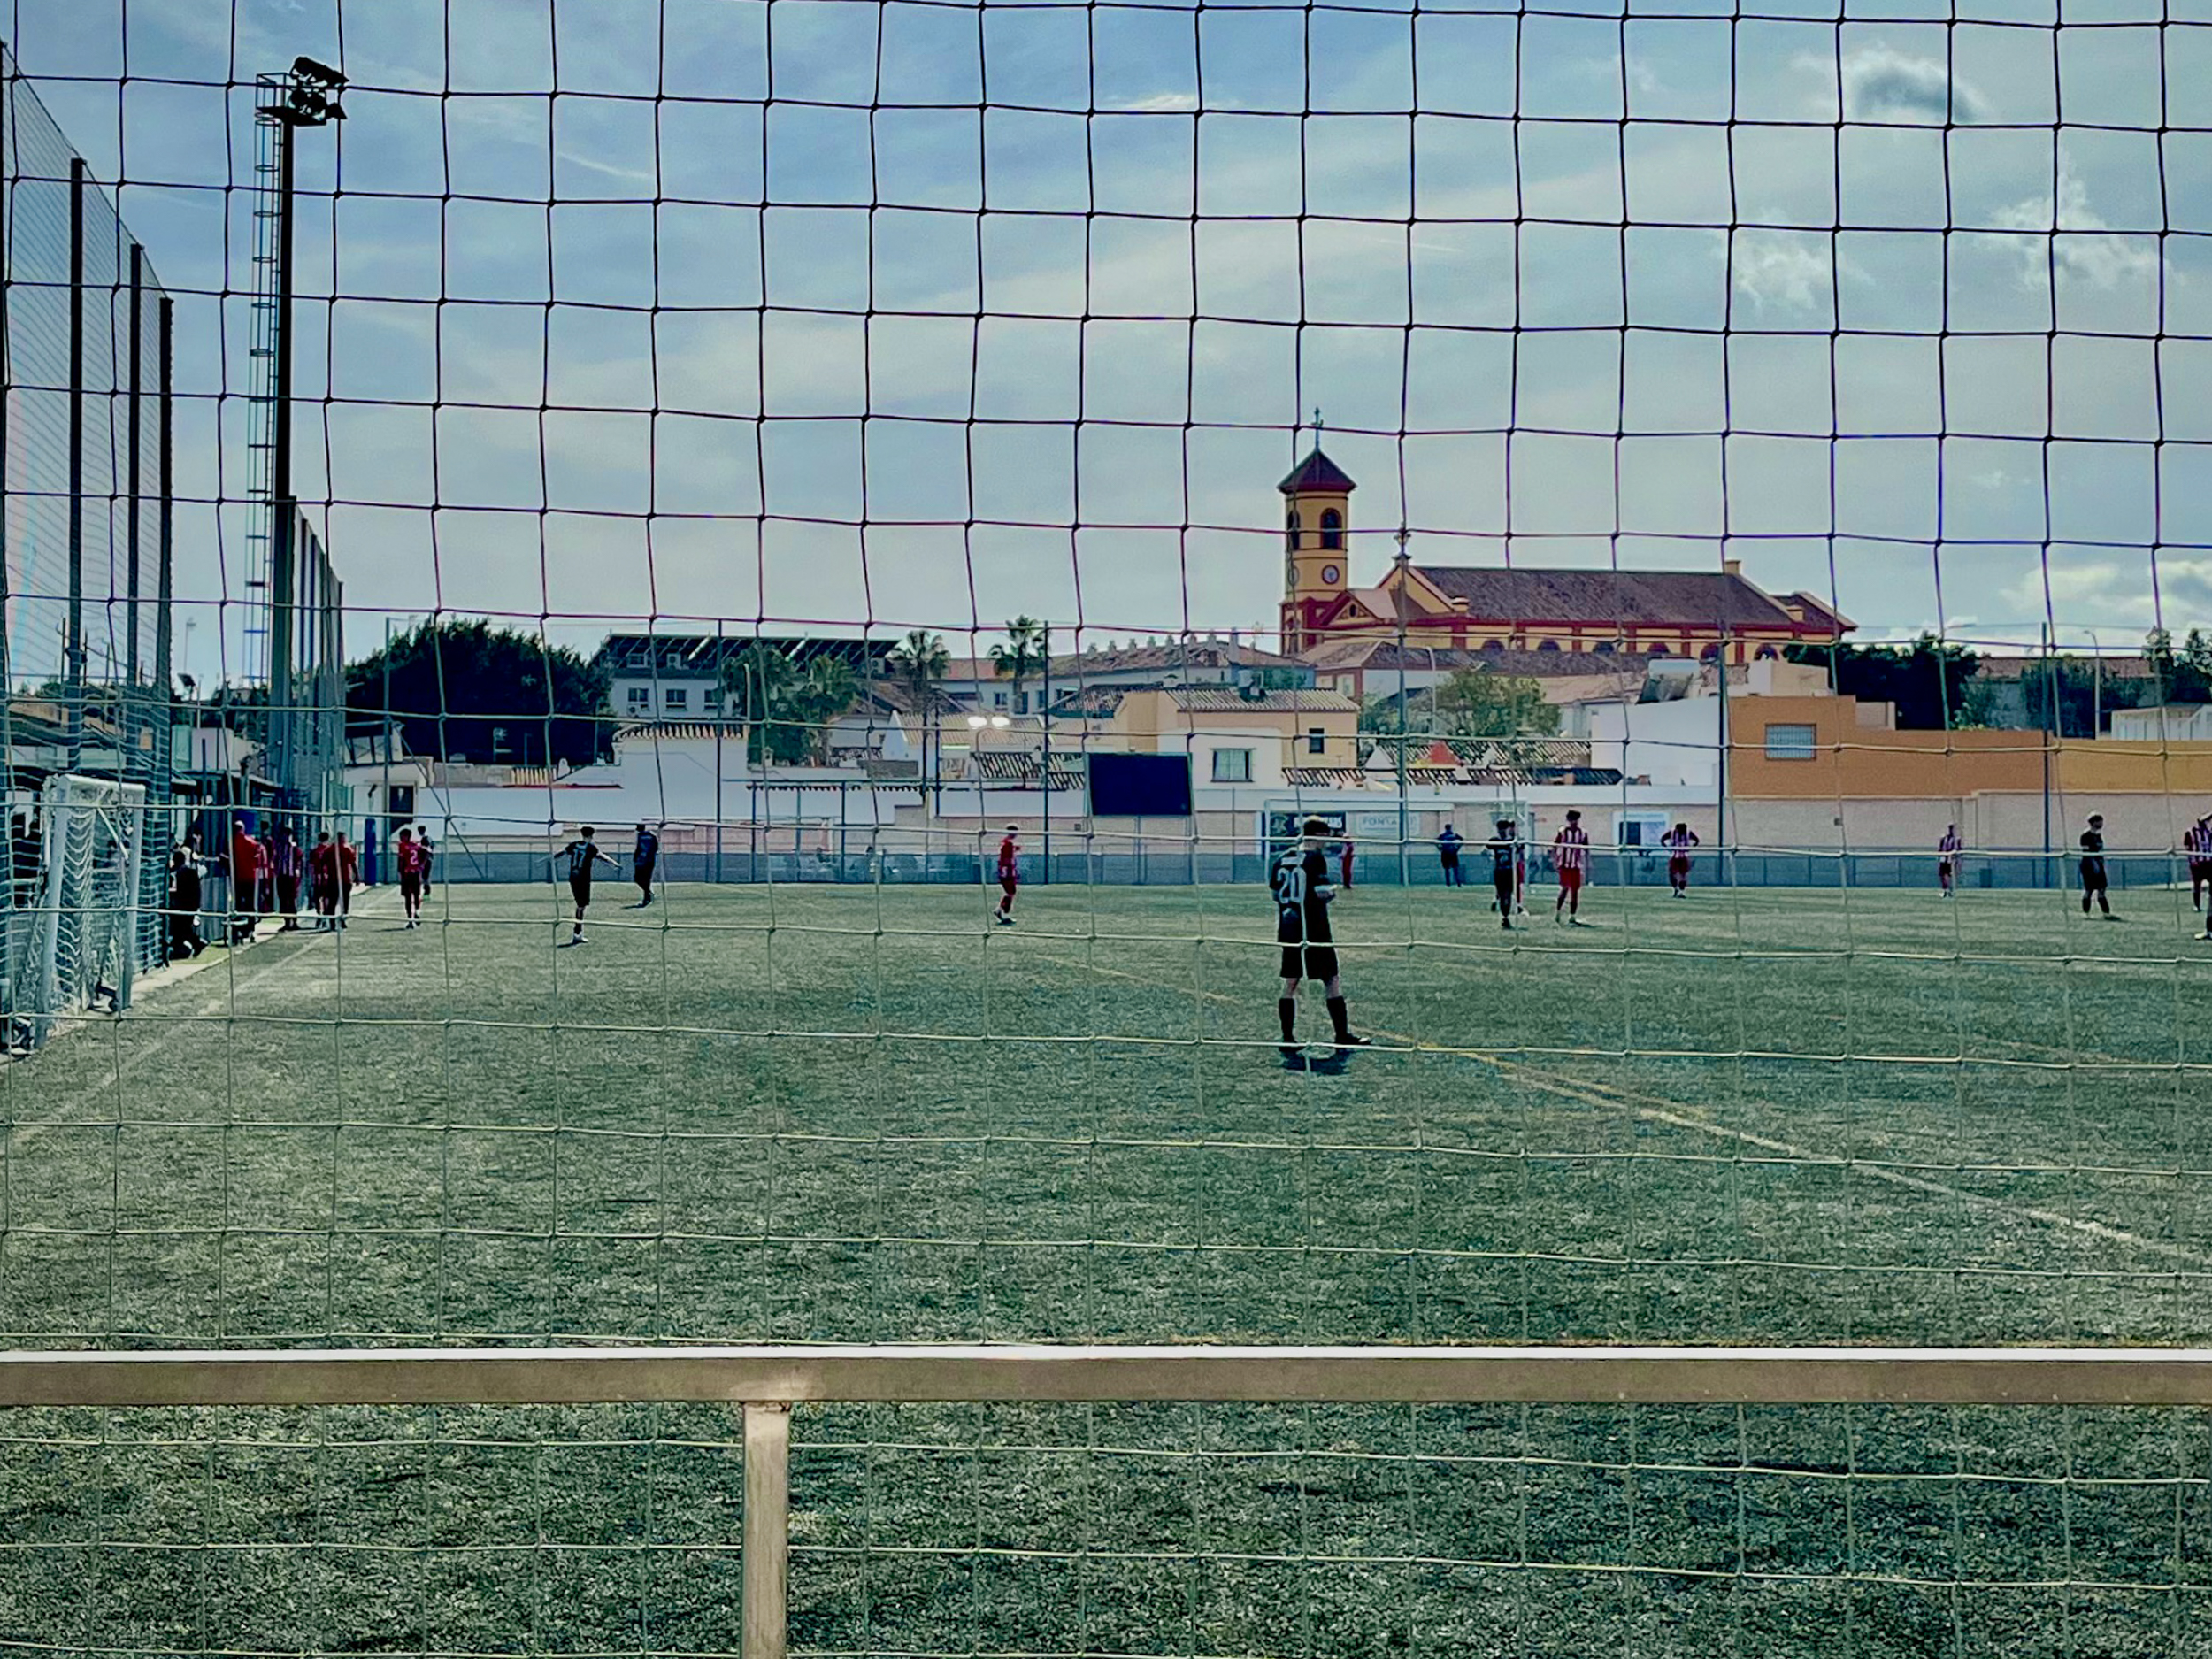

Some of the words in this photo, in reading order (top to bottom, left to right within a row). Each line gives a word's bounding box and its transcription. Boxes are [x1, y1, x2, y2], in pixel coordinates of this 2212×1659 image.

[410, 849, 419, 865] 2
[573, 849, 586, 868] 17
[1277, 867, 1306, 903] 20
